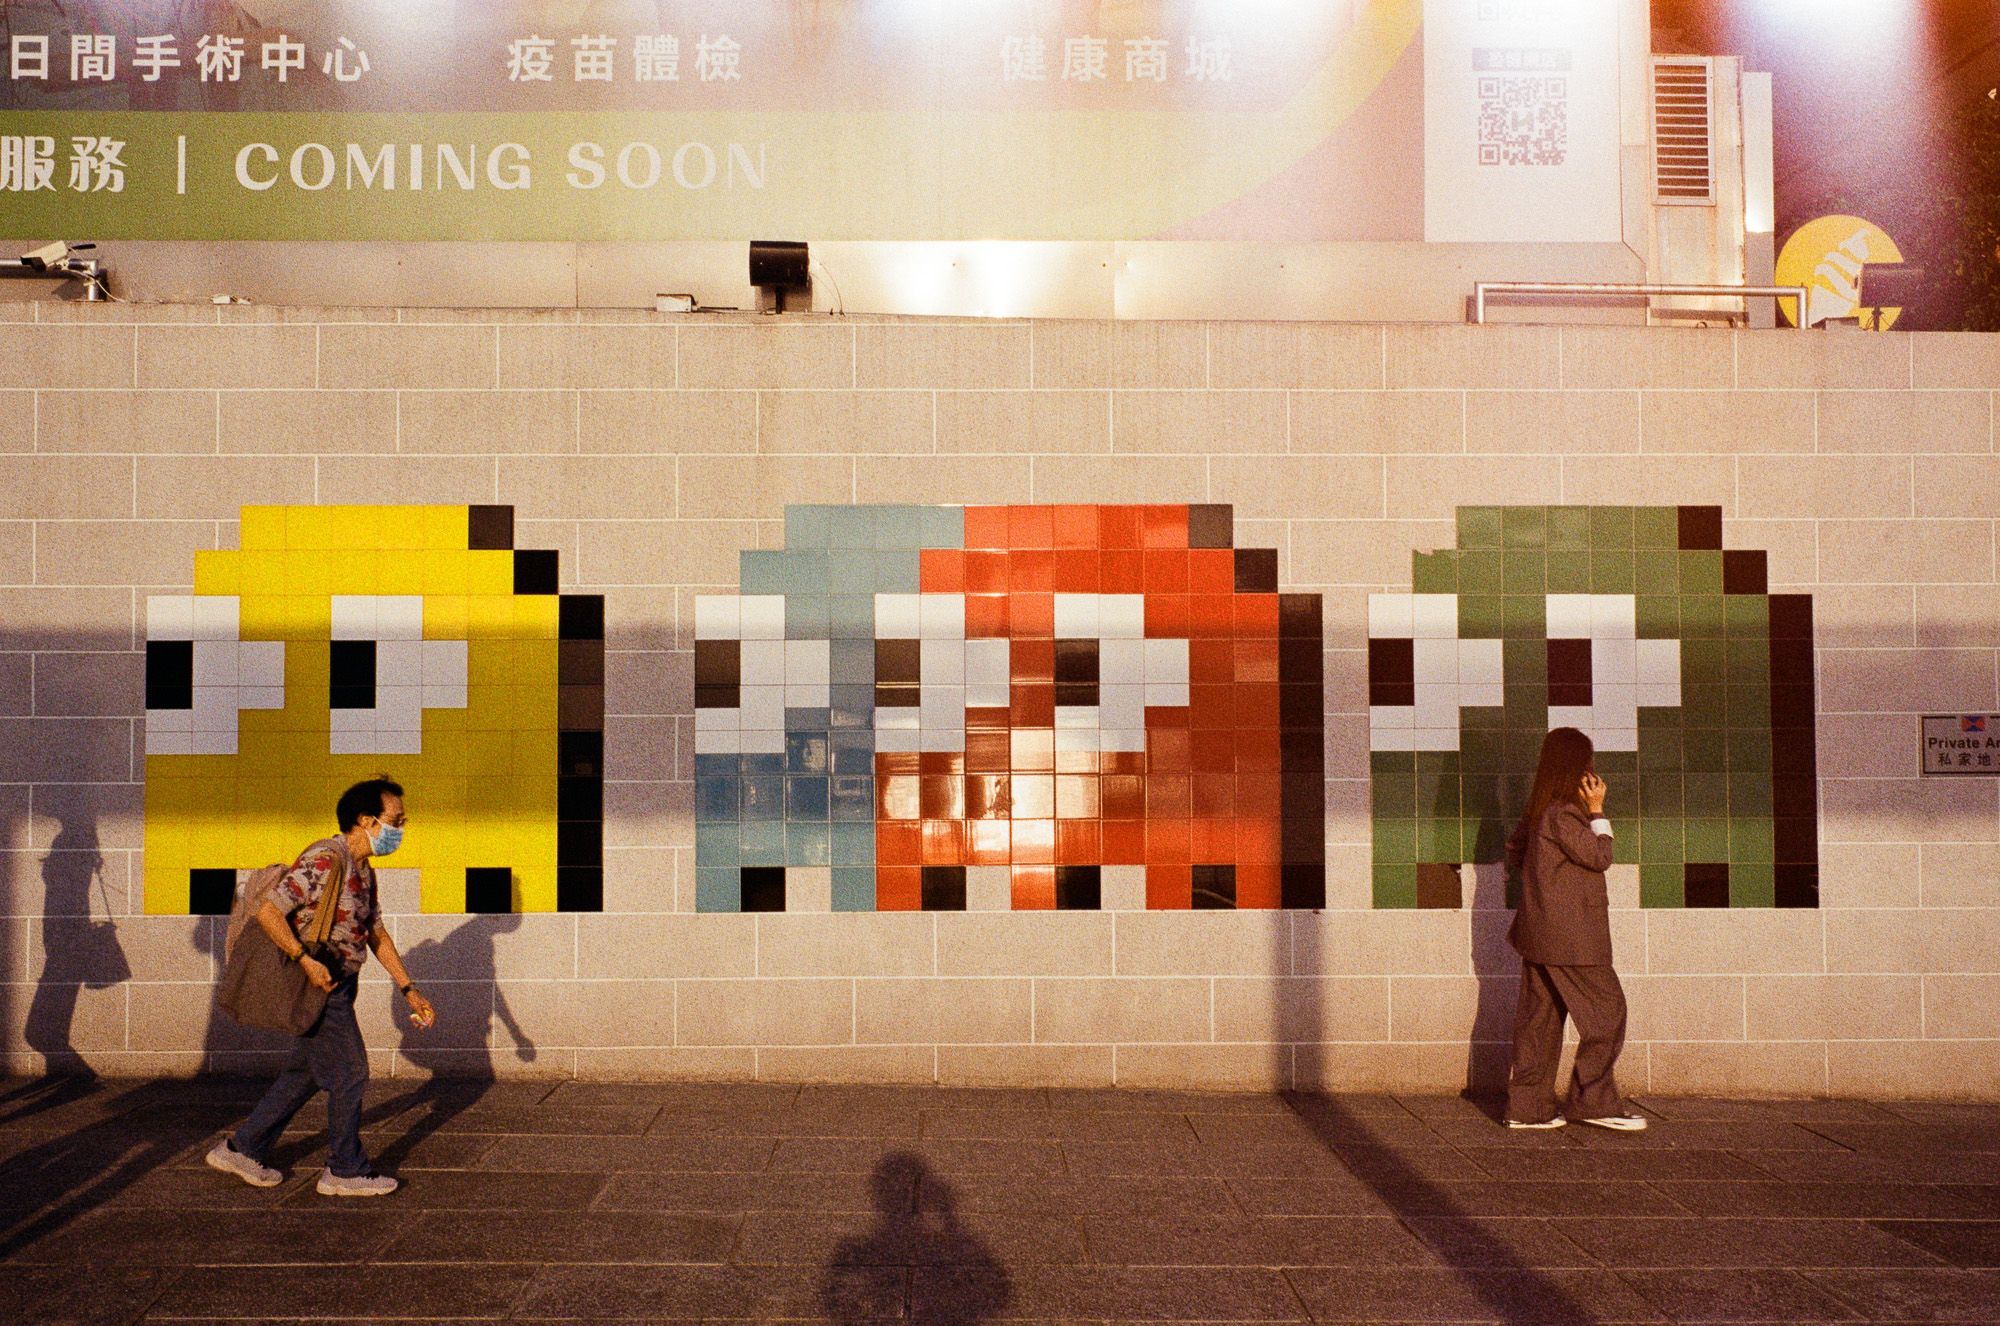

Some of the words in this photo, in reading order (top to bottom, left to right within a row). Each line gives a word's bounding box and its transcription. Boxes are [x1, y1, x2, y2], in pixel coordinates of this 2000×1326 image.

[10, 34, 372, 83] 日間手術中心
[507, 34, 742, 83] 疫苗體檢
[1002, 35, 1234, 82] 健康商城
[0, 135, 127, 193] 服務
[235, 142, 531, 191] COMING
[567, 142, 766, 191] SOON
[1928, 737, 1980, 749] Private
[1938, 752, 2000, 767] 私家地
